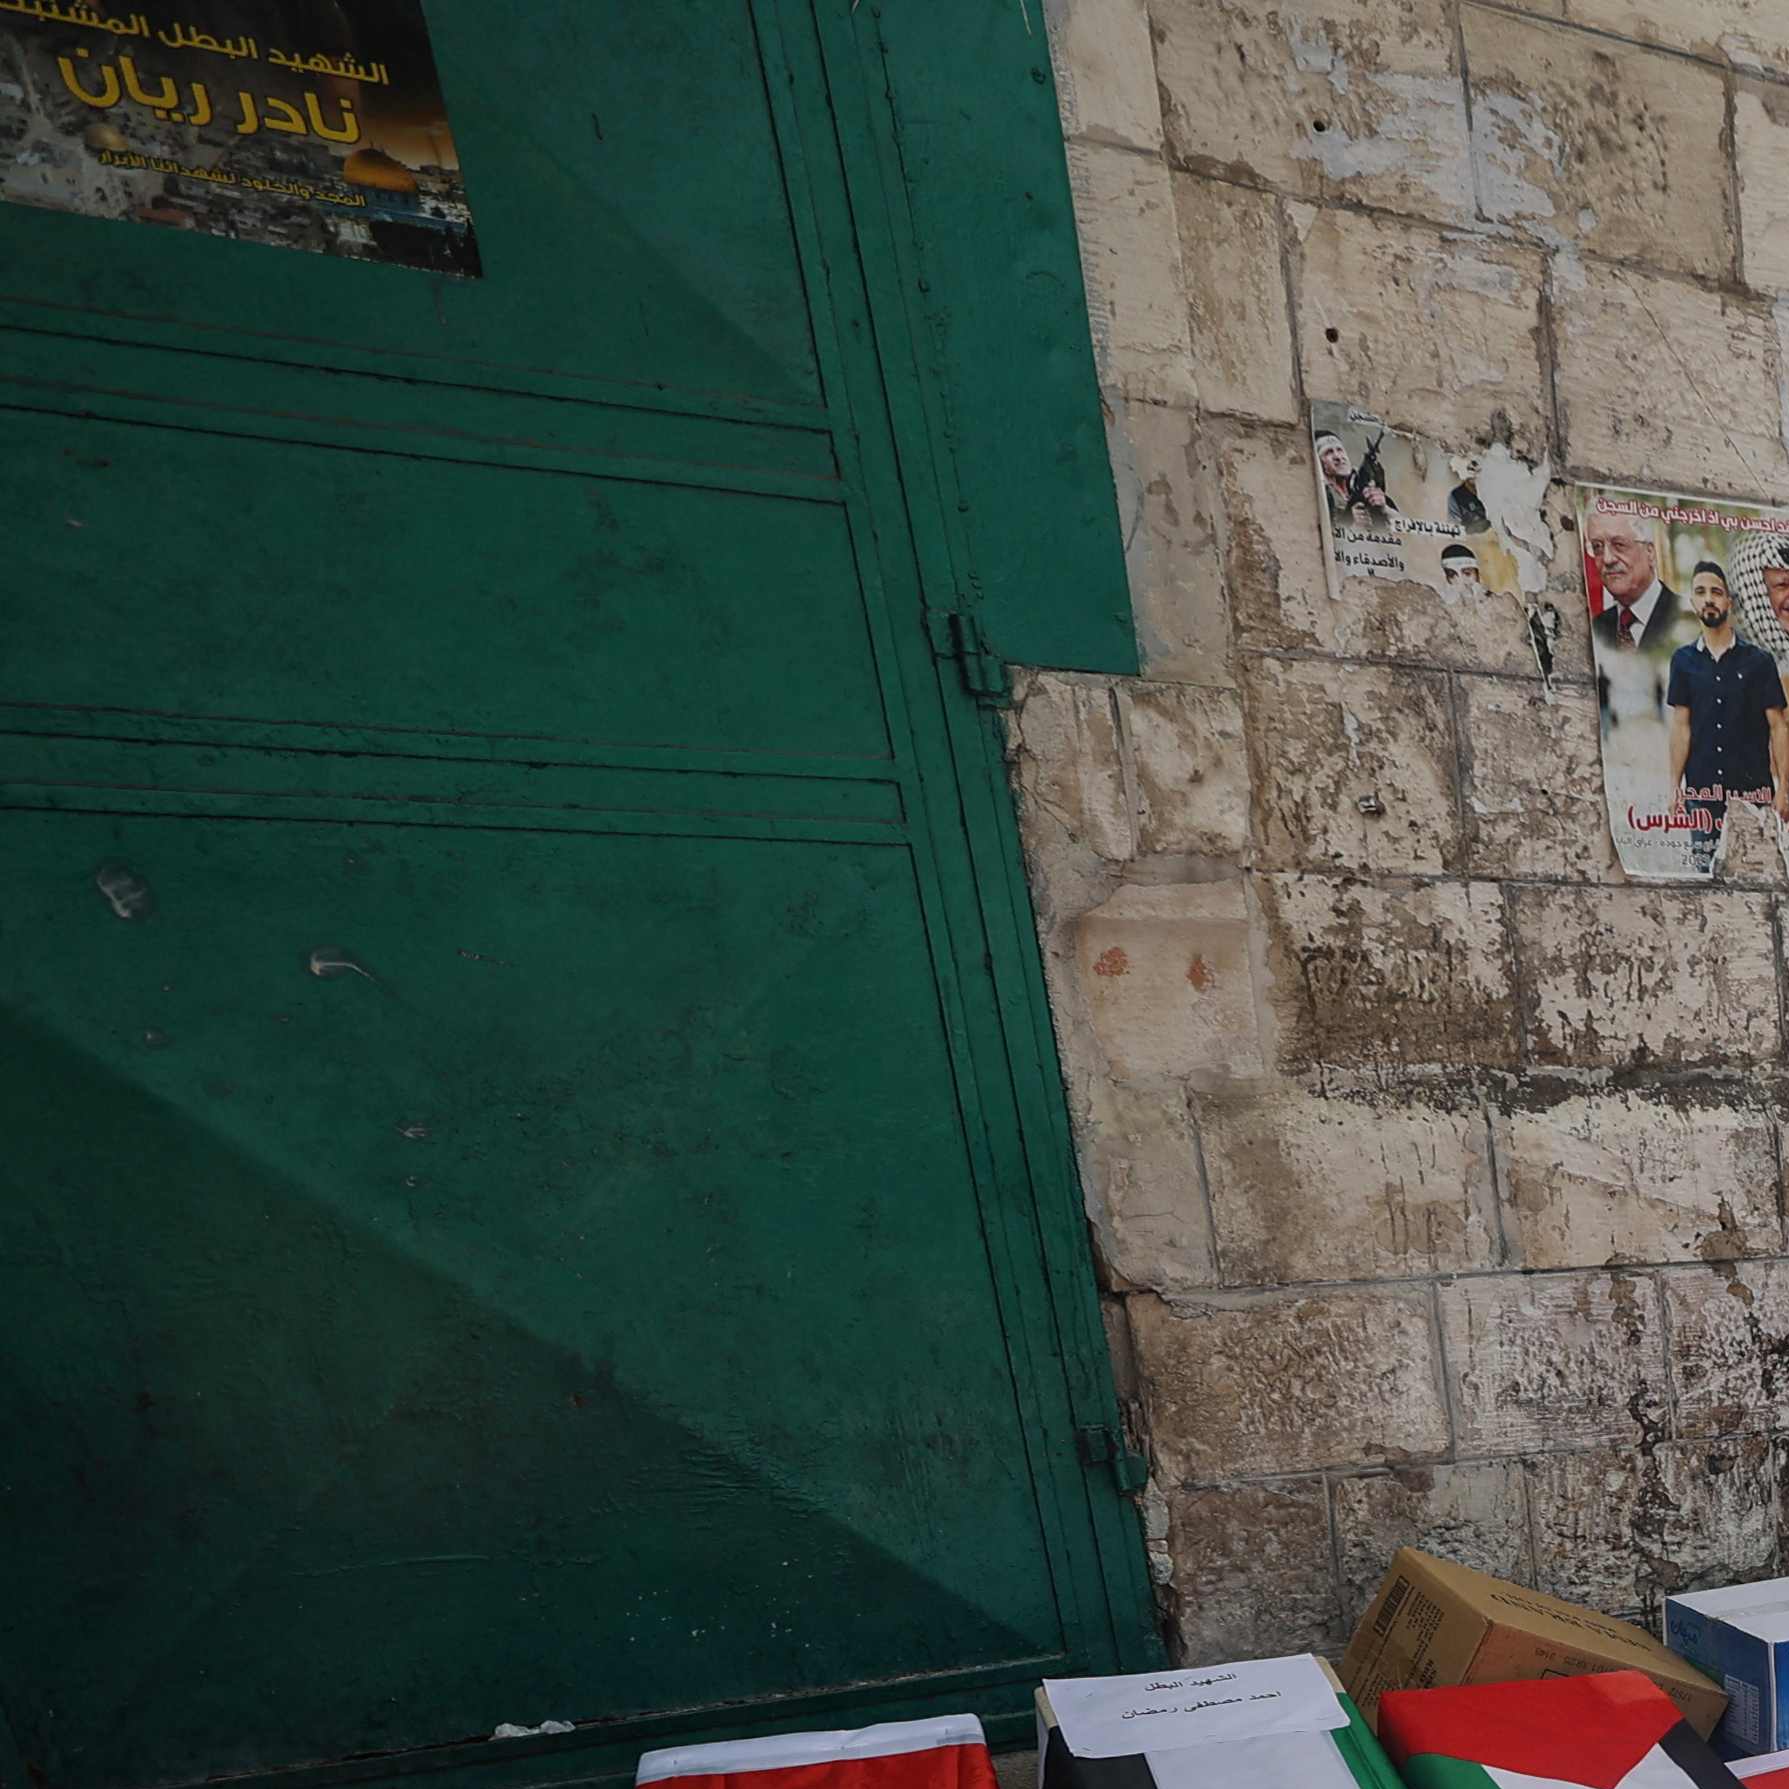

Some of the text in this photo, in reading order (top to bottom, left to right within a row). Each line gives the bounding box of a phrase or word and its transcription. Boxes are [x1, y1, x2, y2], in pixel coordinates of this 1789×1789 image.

[158, 24, 257, 60] البطل
[269, 47, 389, 85] الشهيد
[57, 47, 360, 143] نادر ريان
[1596, 499, 1638, 515] السجن
[1639, 504, 1657, 518] من
[1627, 805, 1713, 833] (الشرس)
[1145, 1674, 1236, 1691] الشهيد البطل
[1250, 1691, 1281, 1700] احمد
[1122, 1708, 1178, 1719] رمضان
